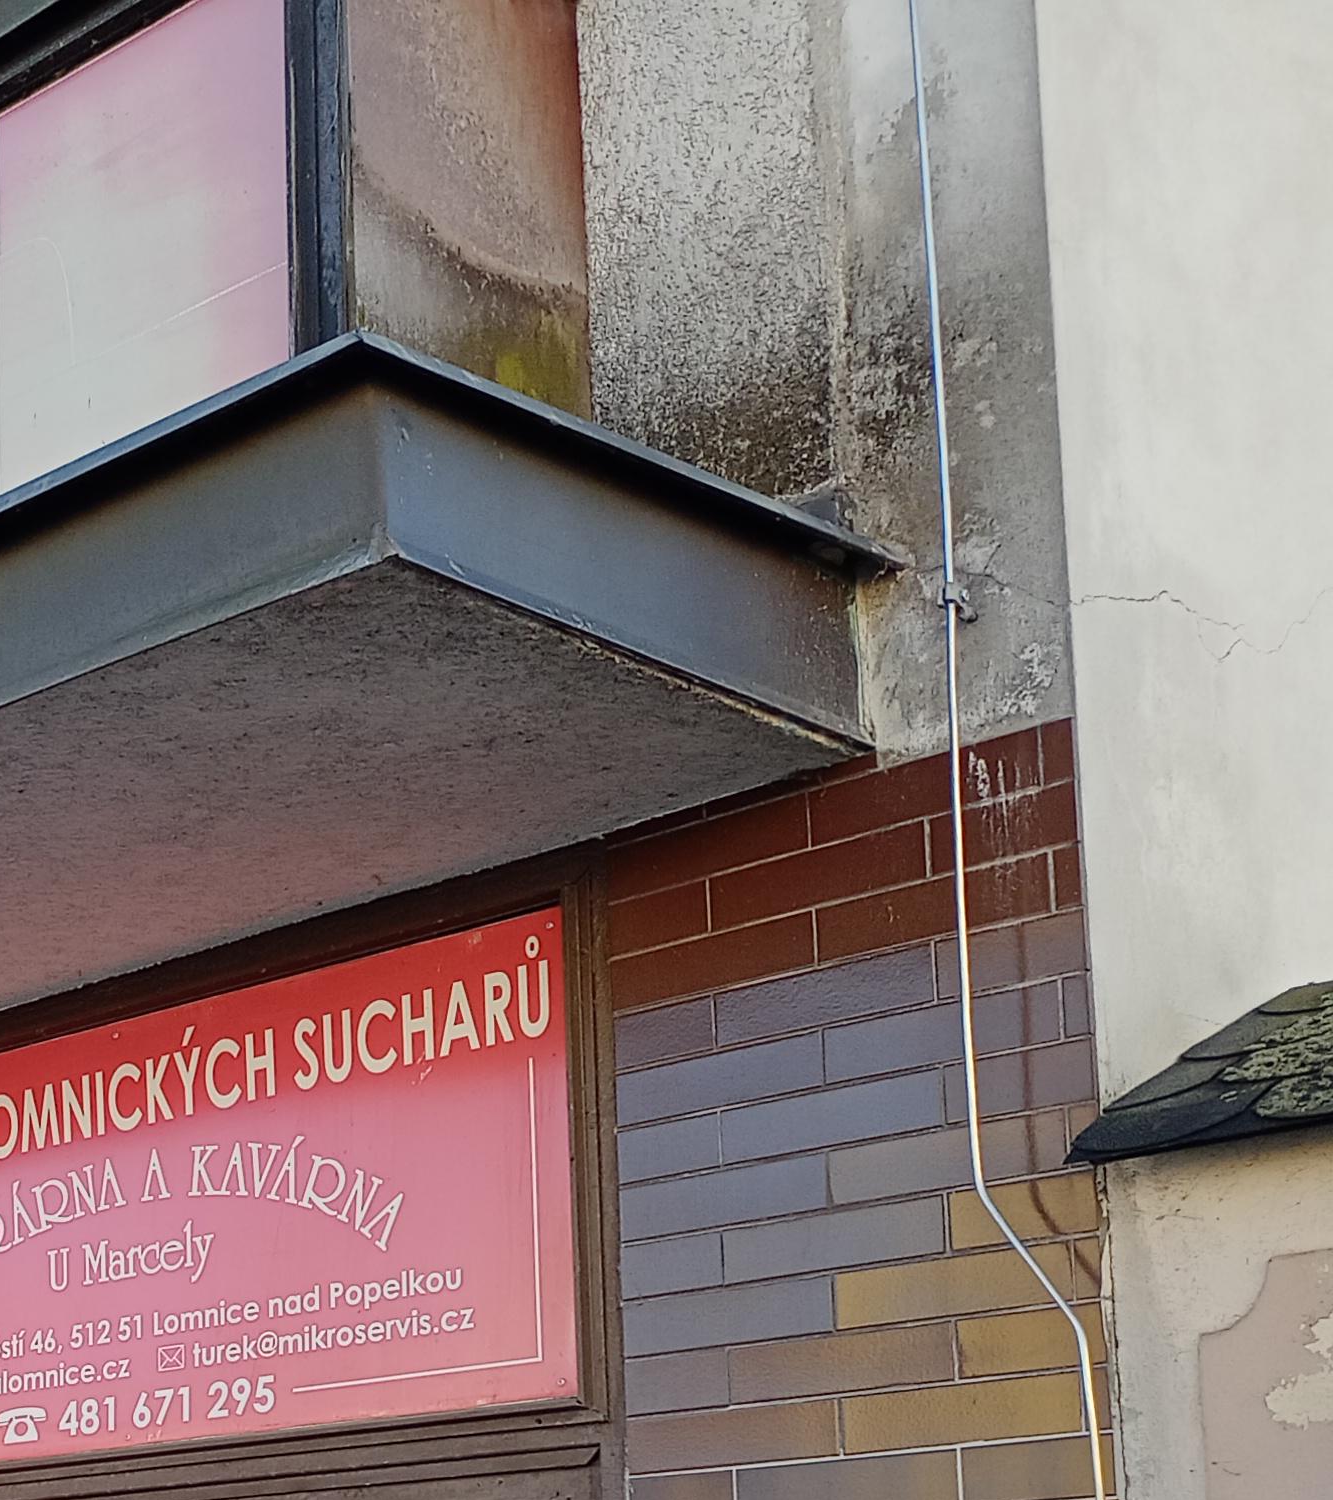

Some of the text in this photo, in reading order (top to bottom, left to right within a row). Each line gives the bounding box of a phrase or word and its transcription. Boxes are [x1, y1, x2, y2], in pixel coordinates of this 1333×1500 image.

[293, 935, 550, 1091] SUCHARŮ
[140, 1147, 172, 1203] A
[187, 1135, 406, 1253] KAVÁRNA
[46, 1218, 215, 1292] U Marcely
[29, 1328, 64, 1355] 46,
[69, 1319, 112, 1349] 512
[117, 1313, 143, 1342] 51
[153, 1299, 260, 1337] Lomnice
[267, 1284, 321, 1319] nad
[329, 1267, 463, 1310] Popelkou
[192, 1306, 475, 1368] turek@mikroservis.cz
[58, 1374, 276, 1437] 481 671 295
